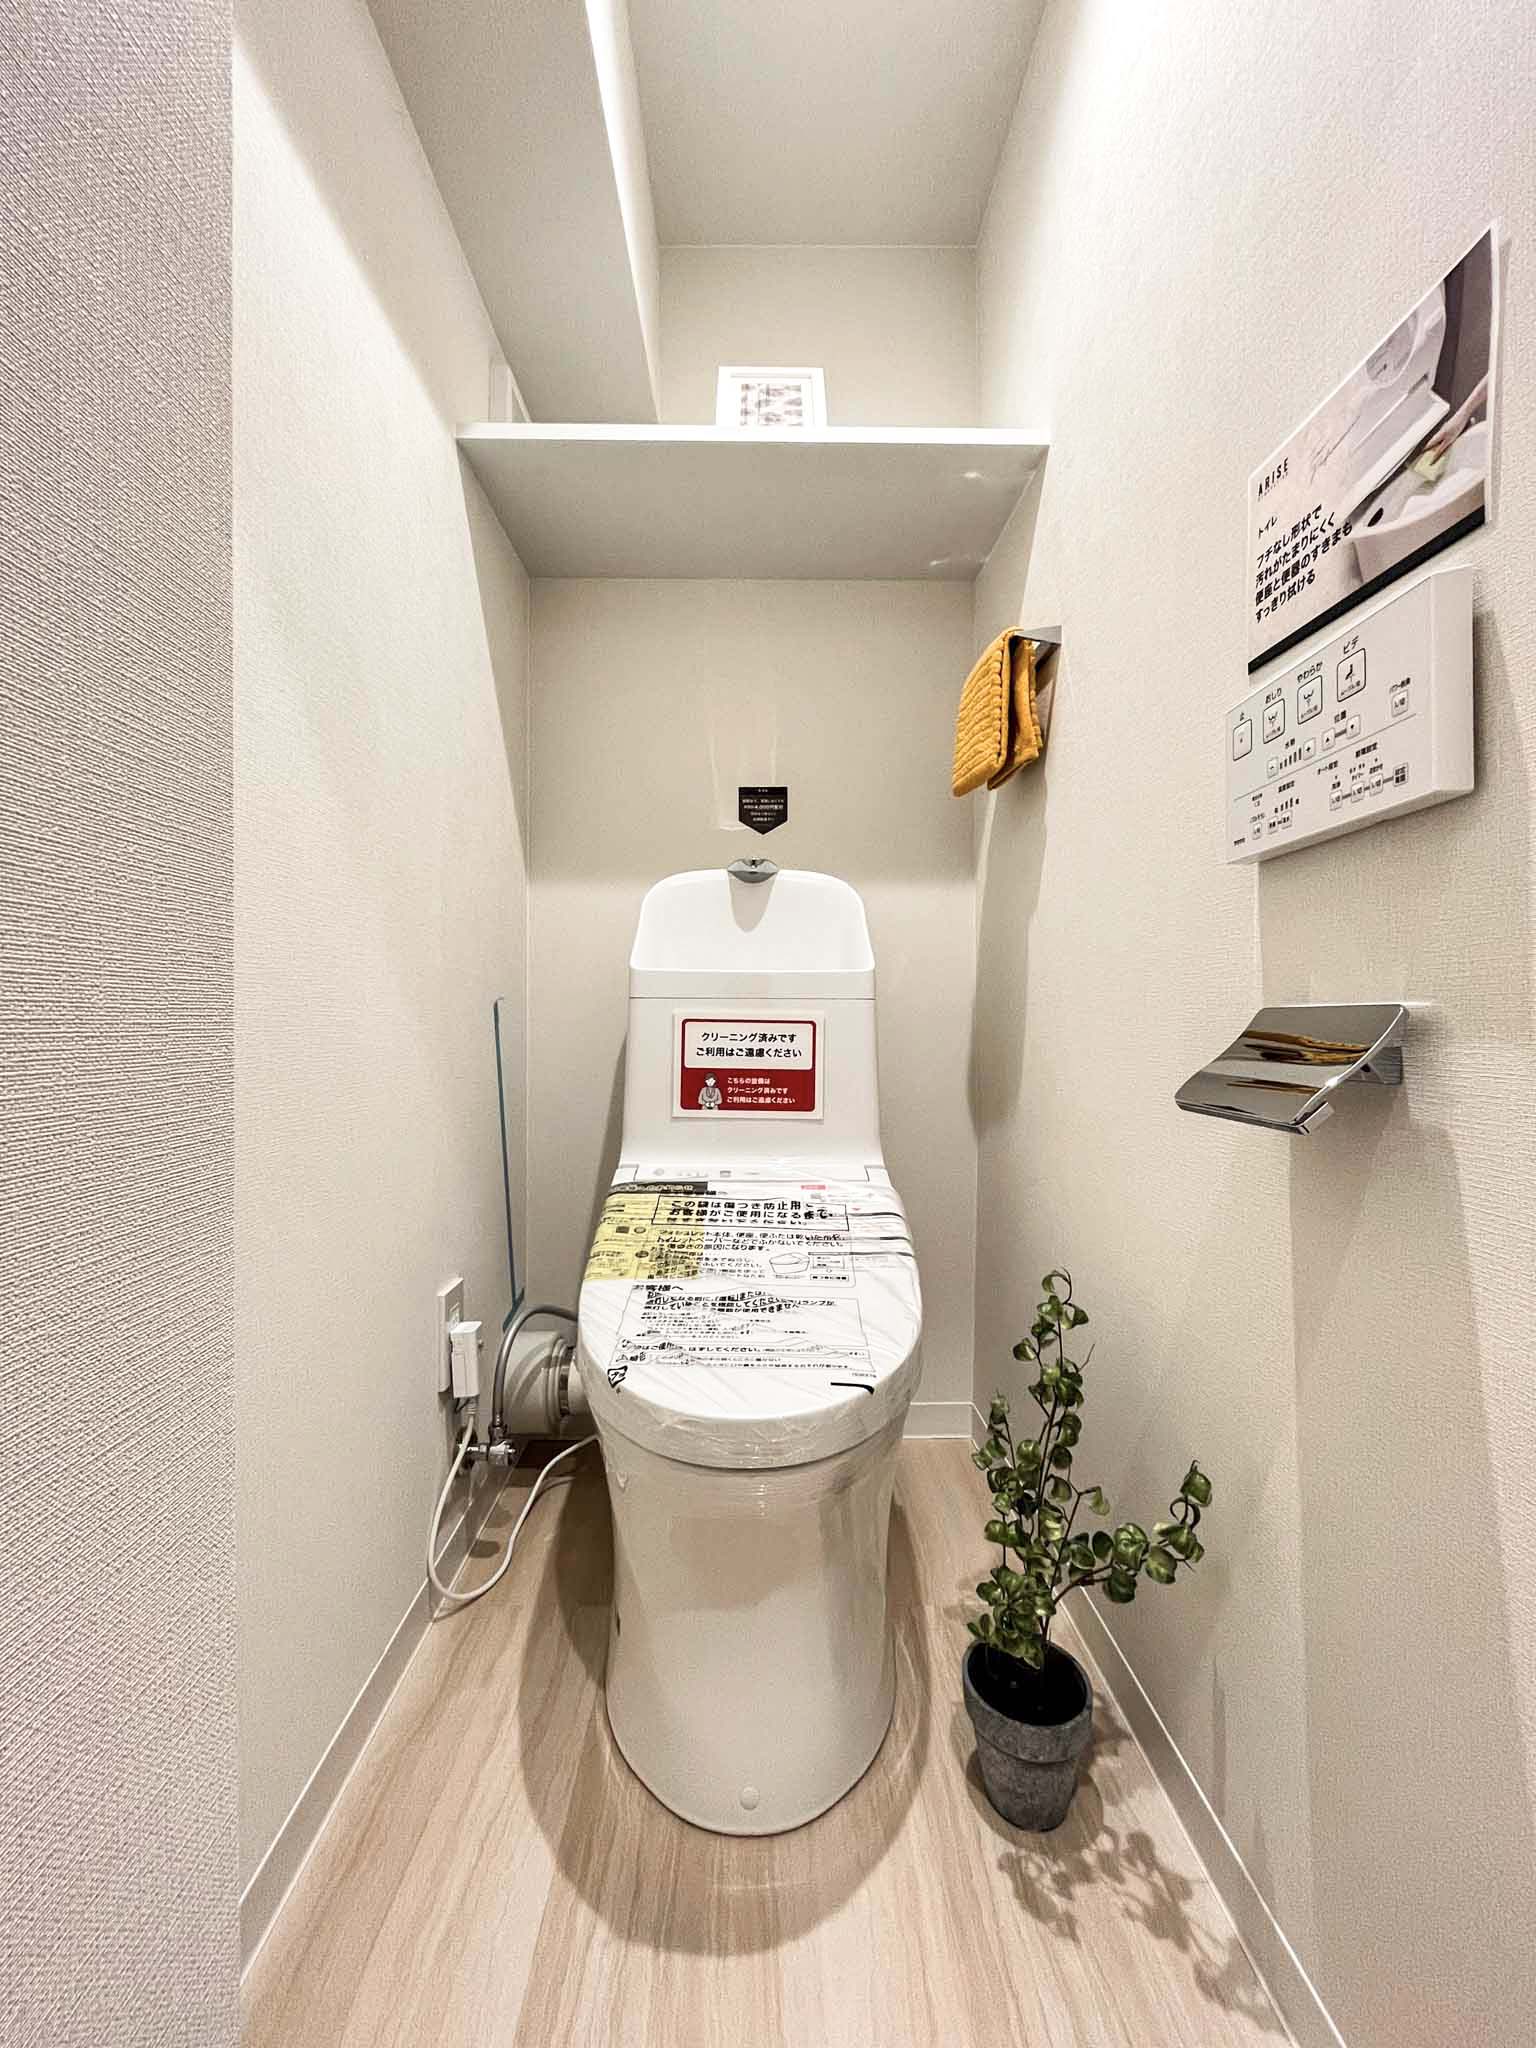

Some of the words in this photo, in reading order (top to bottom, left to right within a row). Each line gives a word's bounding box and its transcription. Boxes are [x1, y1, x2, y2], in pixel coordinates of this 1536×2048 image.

[1258, 457, 1289, 497] ARISE
[1256, 504, 1322, 569] フチなし形状で
[1258, 516, 1278, 539] トイレ
[1256, 512, 1335, 588] 汚れがたまりにくく
[1255, 520, 1352, 607] 便座と便器のすきまも
[1256, 568, 1315, 623] すっきり拭ける
[701, 1032, 797, 1043] クリーニング済みです
[696, 1047, 802, 1058] ご利用はご遠慮ください
[727, 1077, 771, 1085] こちらの設備は
[727, 1086, 788, 1095] クリーニング済みです
[727, 1096, 796, 1105] ご利用はご遠慮ください
